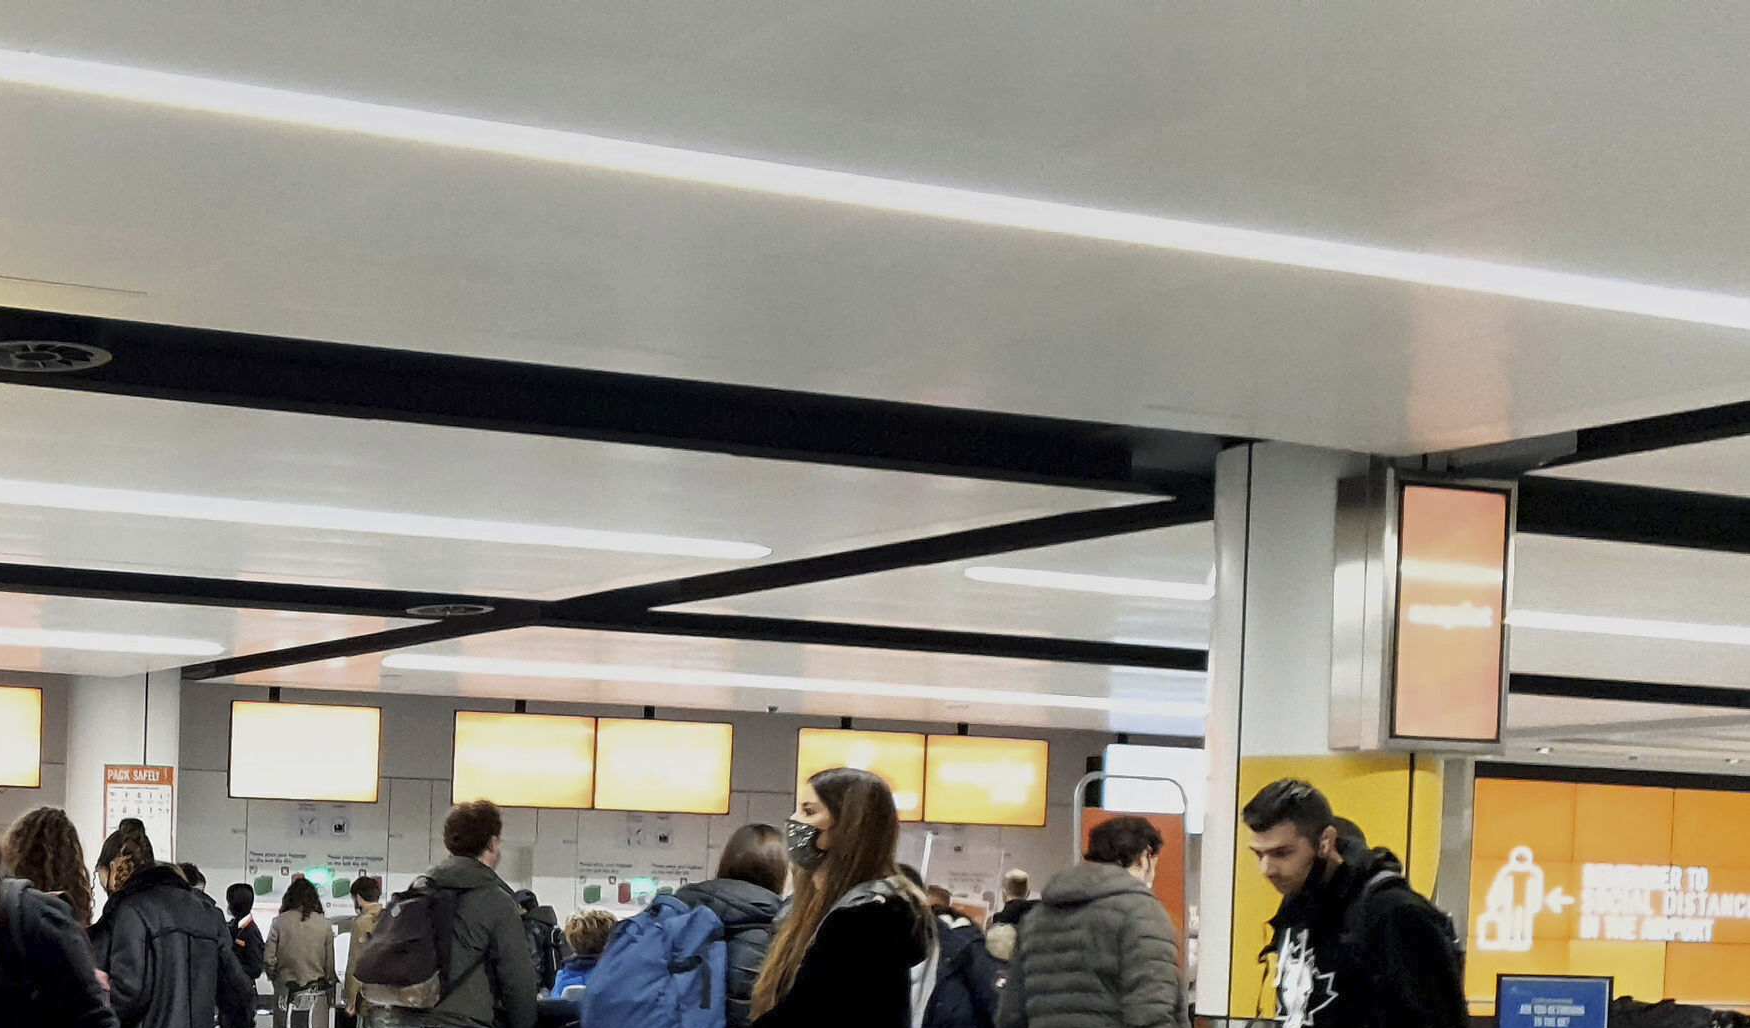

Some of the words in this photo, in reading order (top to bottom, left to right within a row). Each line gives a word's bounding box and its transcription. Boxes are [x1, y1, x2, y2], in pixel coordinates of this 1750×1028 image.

[107, 769, 130, 781] PACK
[132, 769, 160, 782] SAFELY
[1686, 866, 1709, 892] TO
